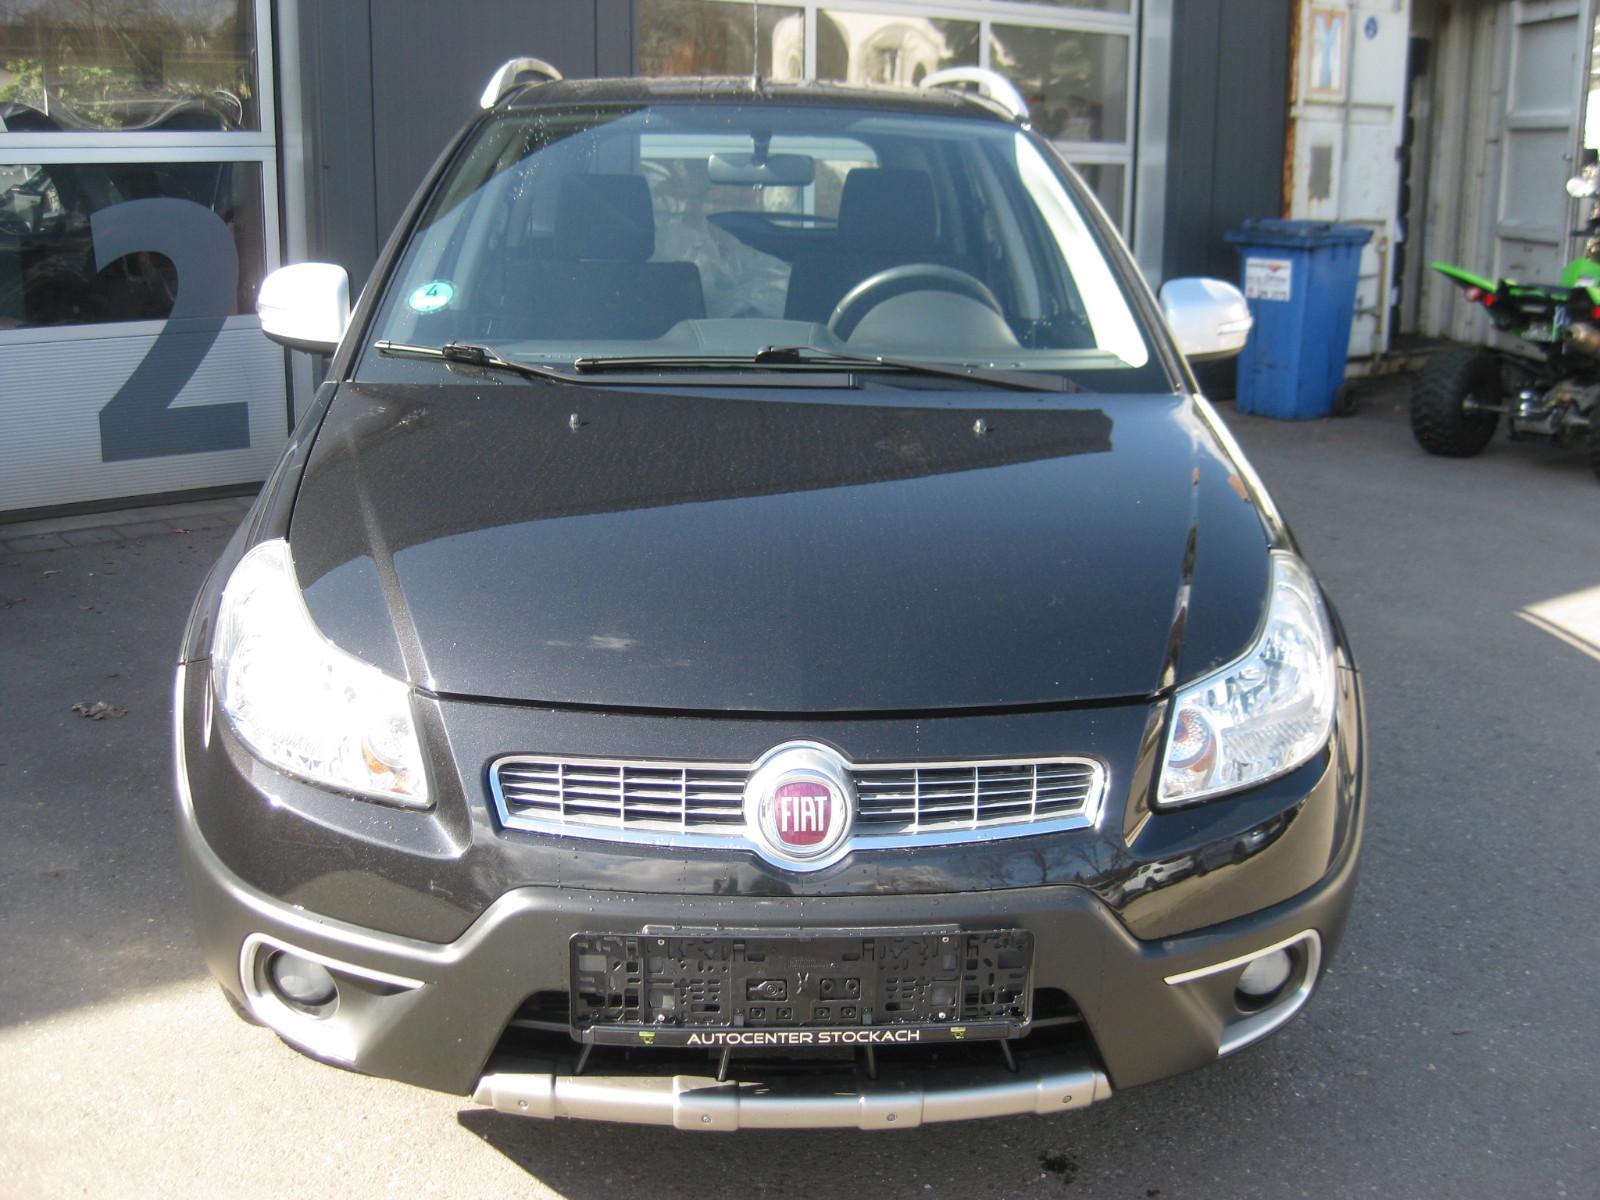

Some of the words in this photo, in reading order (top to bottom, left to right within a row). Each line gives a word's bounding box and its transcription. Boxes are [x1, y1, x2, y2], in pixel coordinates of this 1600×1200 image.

[425, 284, 438, 296] 4
[90, 197, 250, 462] 2
[780, 796, 828, 832] FIAT
[687, 1031, 812, 1045] AUTOCENTER
[818, 1030, 920, 1044] STOCKACH
